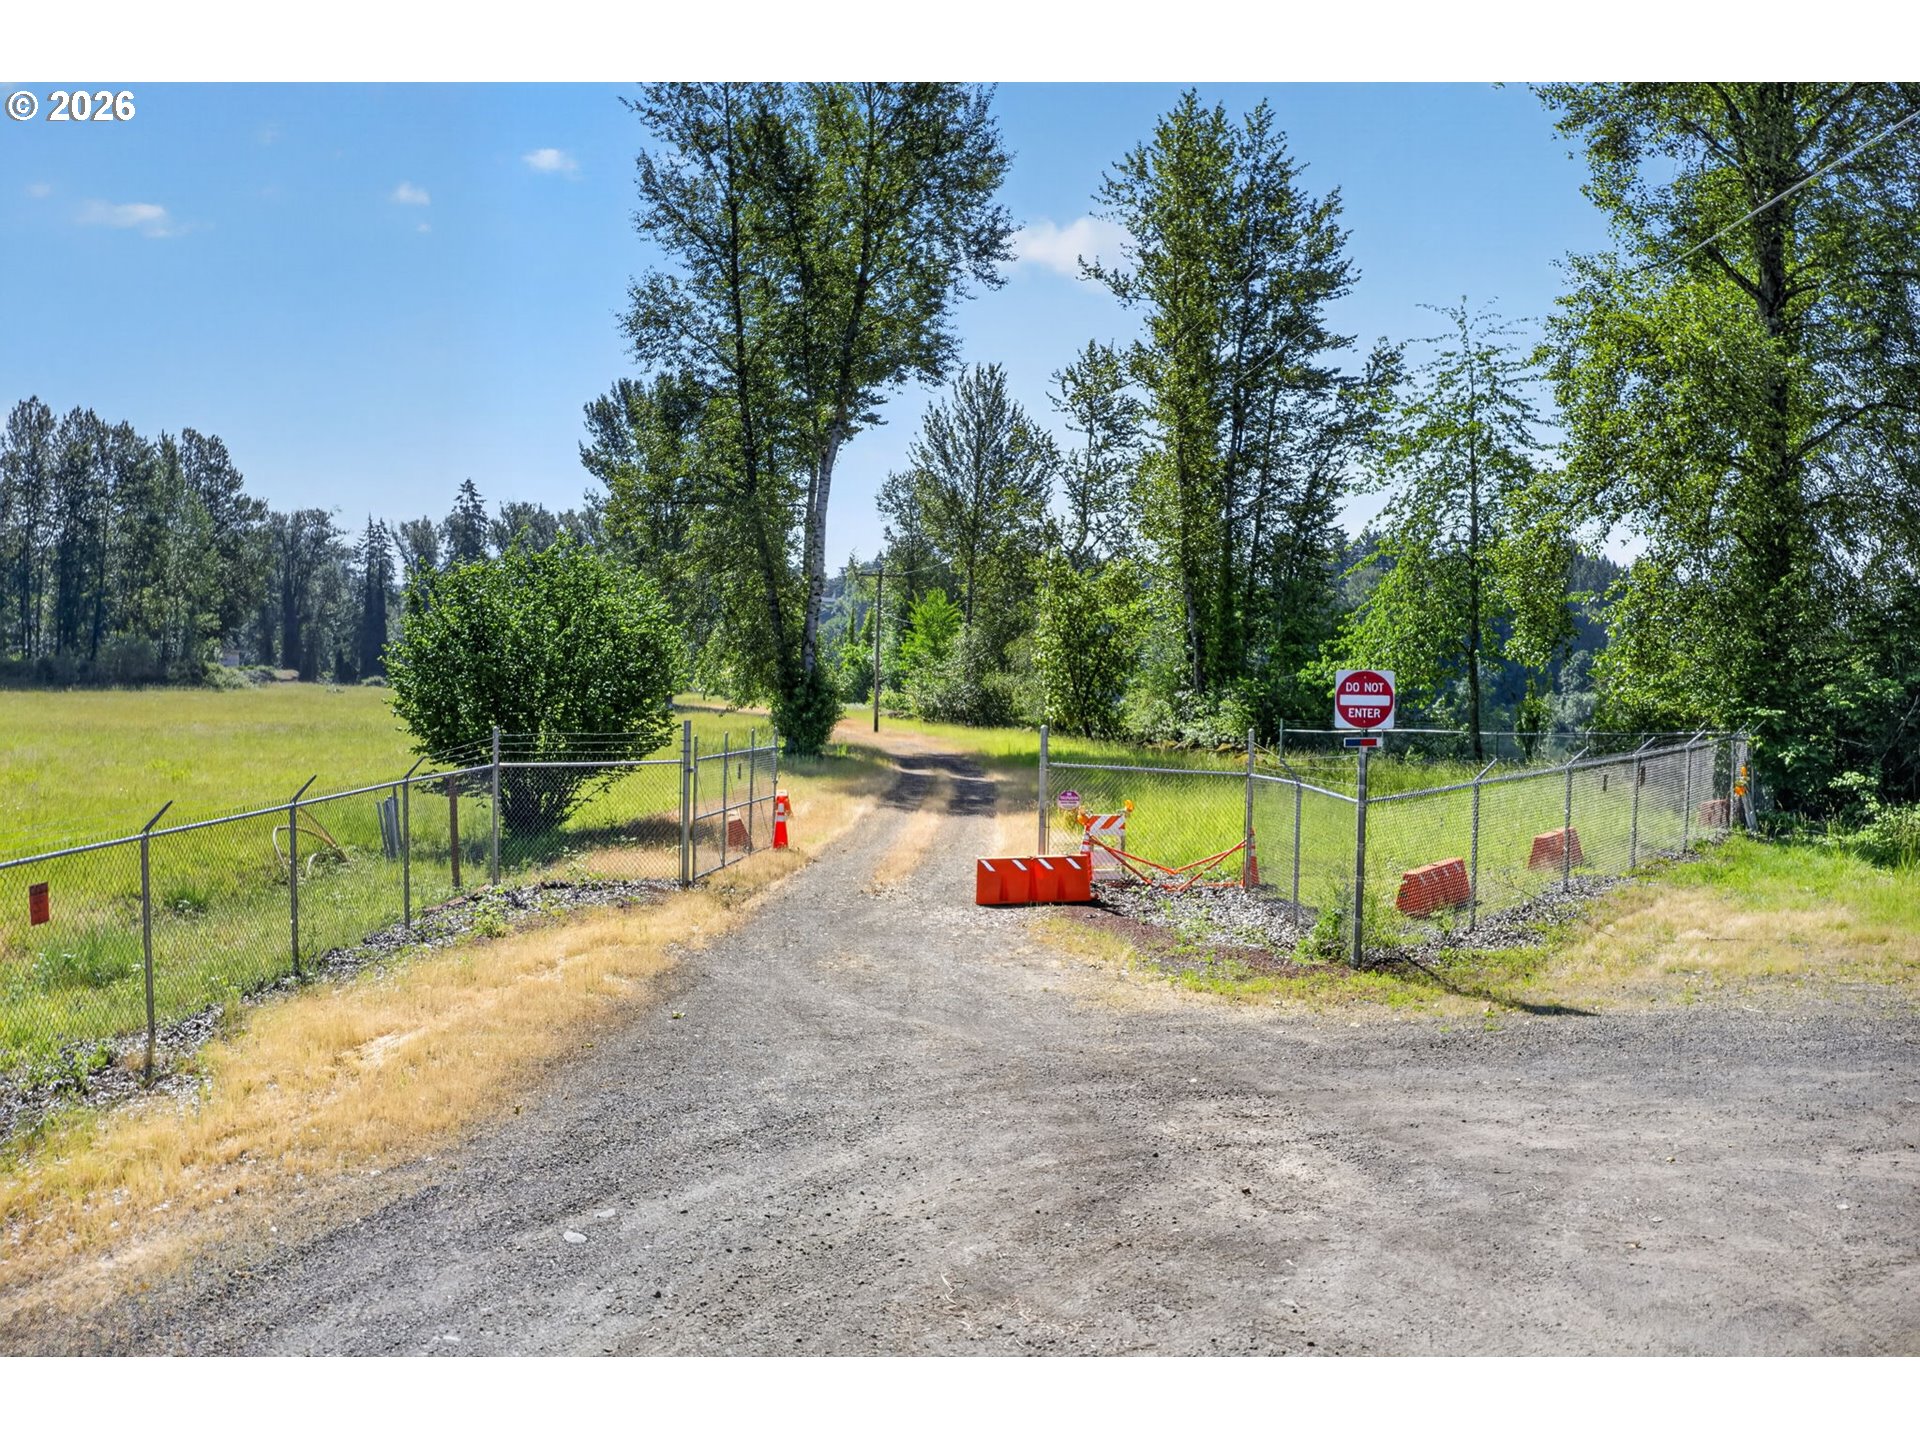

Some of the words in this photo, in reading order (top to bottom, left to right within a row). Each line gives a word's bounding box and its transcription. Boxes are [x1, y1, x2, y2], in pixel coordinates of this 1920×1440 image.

[1345, 682, 1360, 693] DO
[1364, 682, 1384, 693] NOT
[1348, 708, 1381, 719] ENTER
